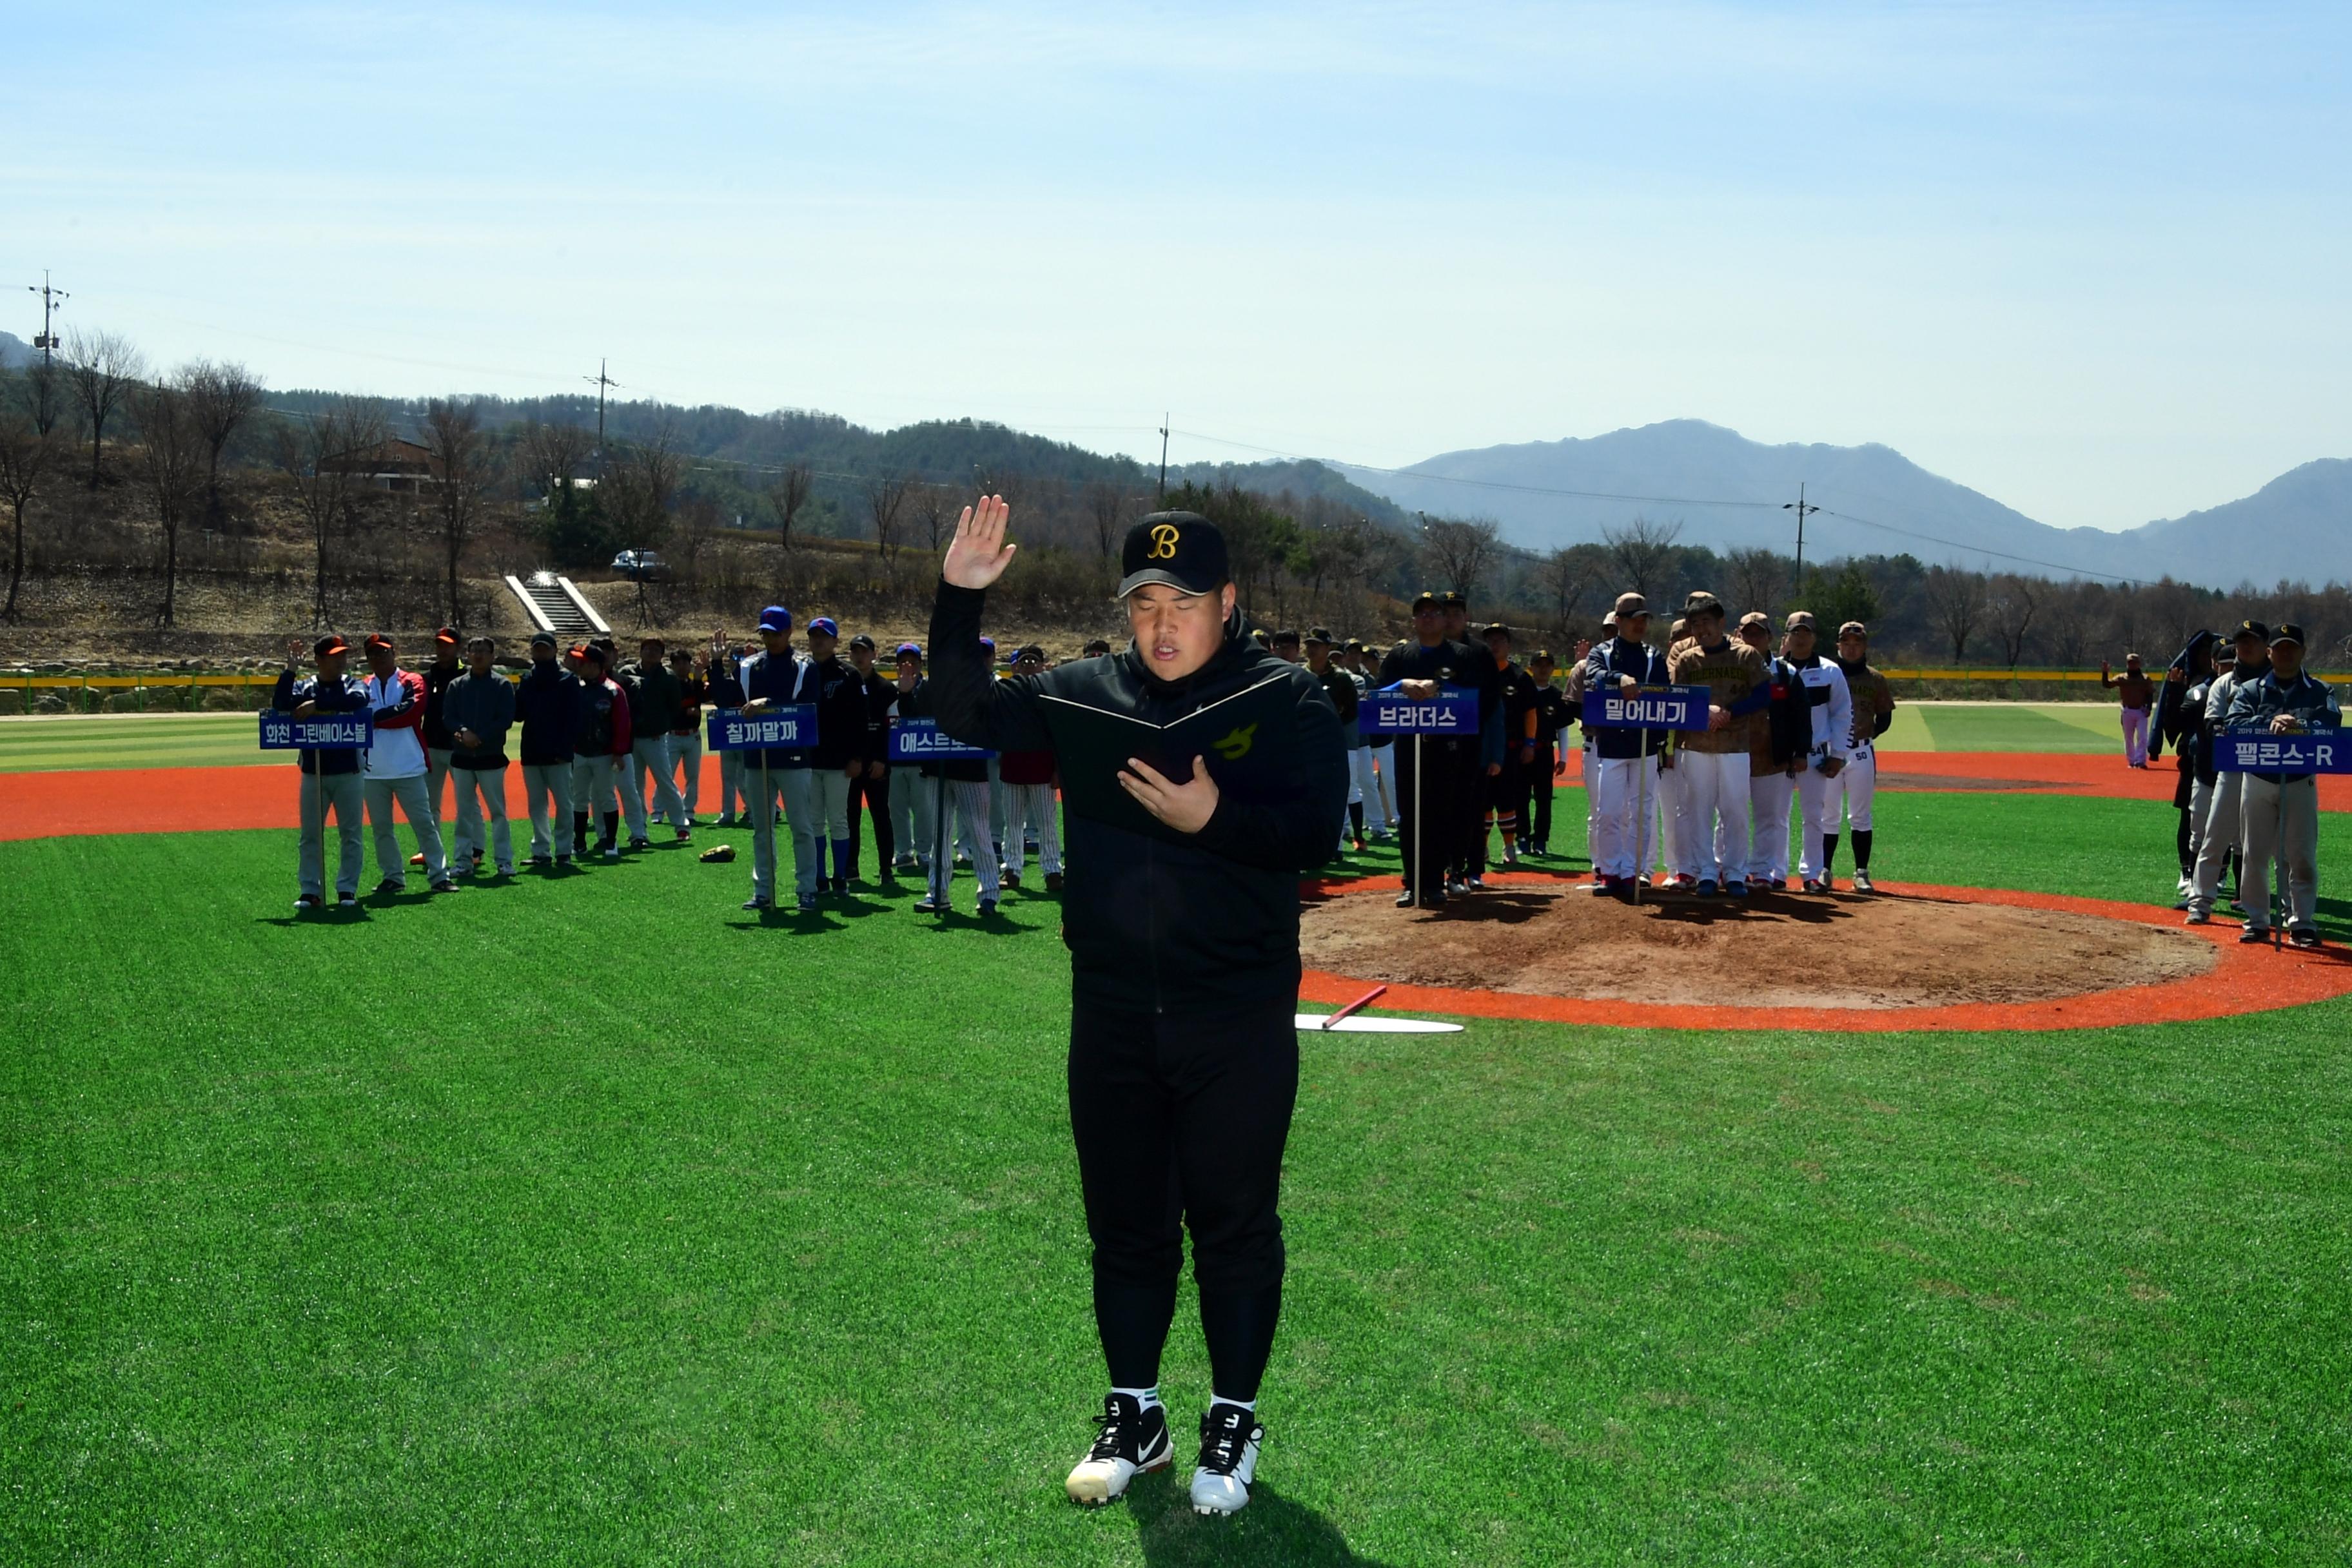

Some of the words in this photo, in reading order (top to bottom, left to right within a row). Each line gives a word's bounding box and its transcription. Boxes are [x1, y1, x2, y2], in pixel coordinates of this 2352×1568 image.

[1147, 524, 1180, 559] B
[1378, 706, 1457, 727] 브라더스
[1605, 698, 1687, 724] 밀어내기
[265, 723, 290, 744] 화천
[295, 722, 367, 743] 그린베이스볼
[726, 720, 798, 744] 칠까말까
[899, 732, 985, 753] 애스트
[1855, 751, 1868, 761] 50
[2235, 742, 2333, 766] 팰콘스-R
